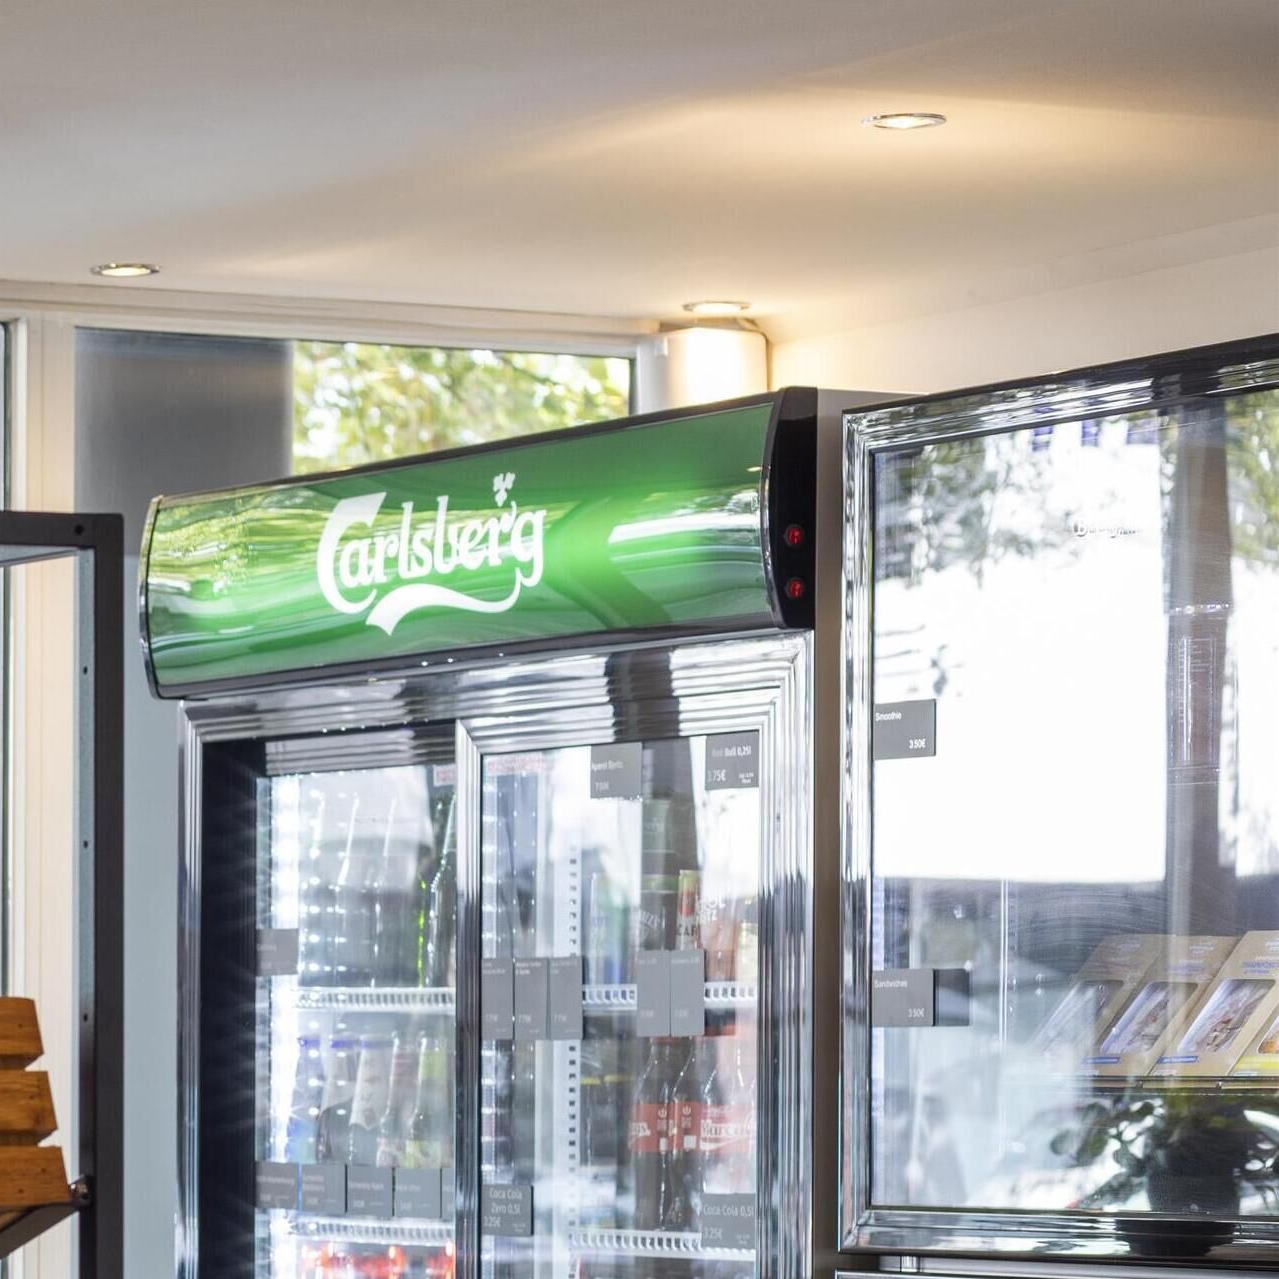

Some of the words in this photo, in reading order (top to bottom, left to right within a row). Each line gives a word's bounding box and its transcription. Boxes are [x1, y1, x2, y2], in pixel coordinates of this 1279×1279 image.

[317, 490, 547, 618] Carlsberg
[875, 711, 902, 721] Smoothie
[489, 1187, 506, 1199] Coca
[506, 1188, 523, 1200] Cola
[491, 1202, 506, 1213] Zero
[704, 1204, 721, 1216] Coca
[722, 1205, 739, 1216] Cola
